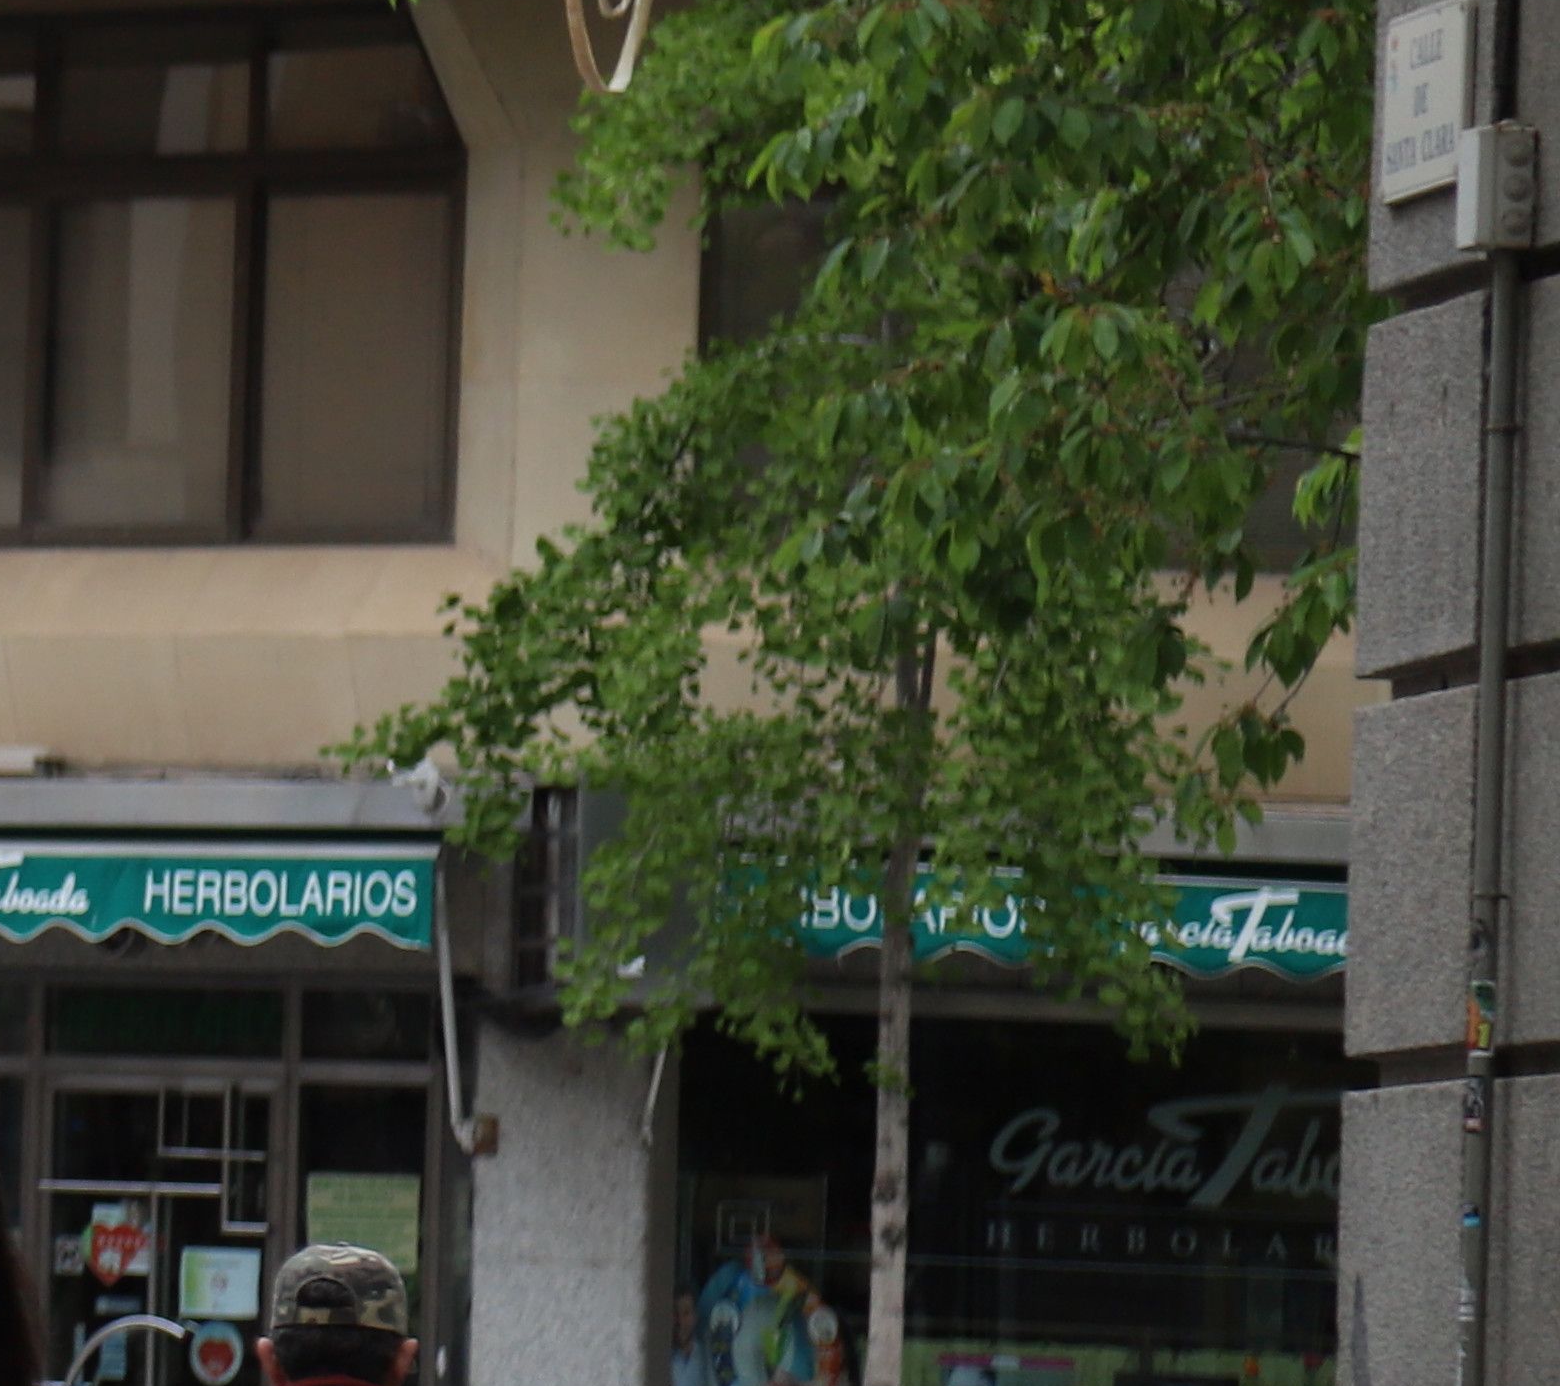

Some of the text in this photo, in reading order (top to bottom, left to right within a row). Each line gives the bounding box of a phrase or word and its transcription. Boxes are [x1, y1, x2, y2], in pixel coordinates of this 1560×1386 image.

[1409, 28, 1443, 70] CALLE
[1413, 83, 1428, 117] DE
[1385, 121, 1455, 175] SANTA CLARA
[143, 868, 419, 918] HERBOLARIOS
